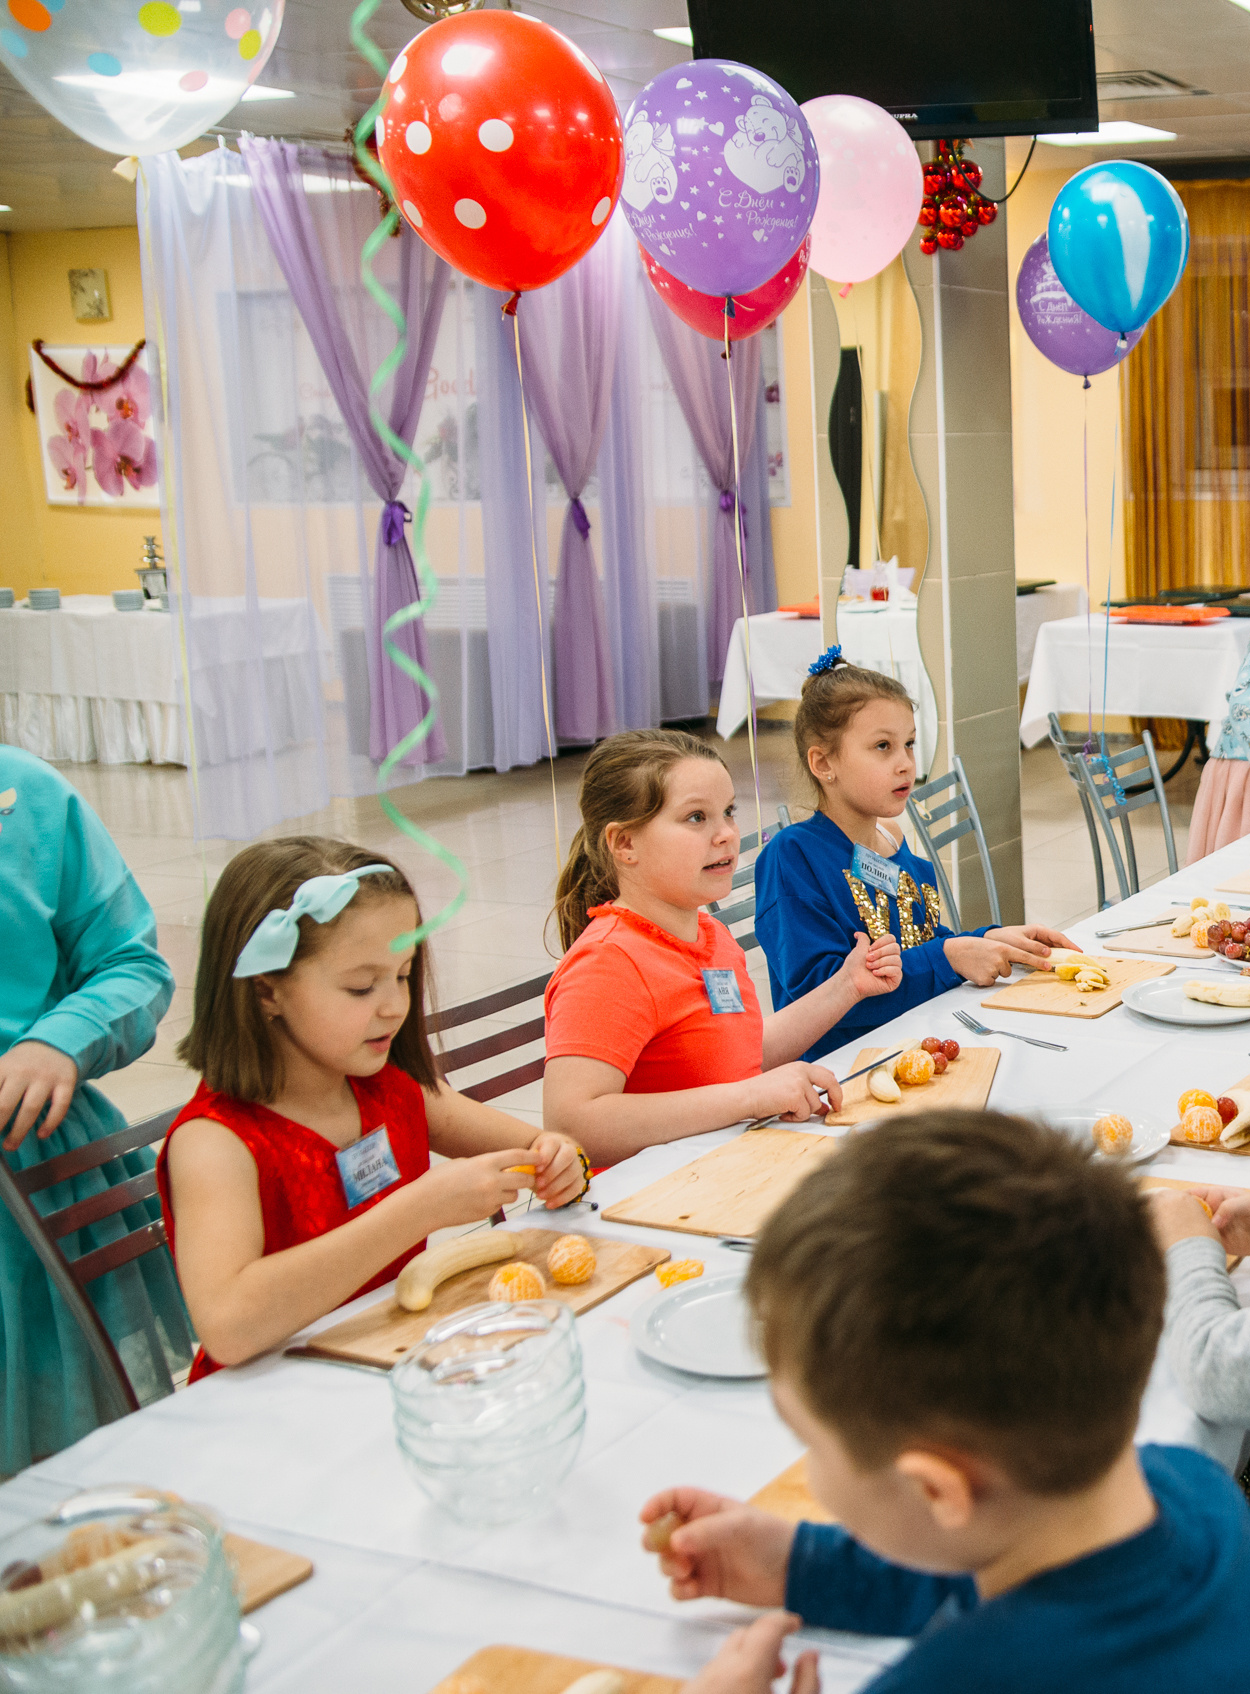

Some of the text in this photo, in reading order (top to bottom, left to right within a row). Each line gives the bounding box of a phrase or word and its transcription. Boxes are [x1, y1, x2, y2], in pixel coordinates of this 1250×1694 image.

[718, 187, 774, 211] С Днём
[745, 210, 799, 232] Рождения!
[643, 222, 697, 246] Рождения!
[861, 862, 892, 883] ПОЛИНА
